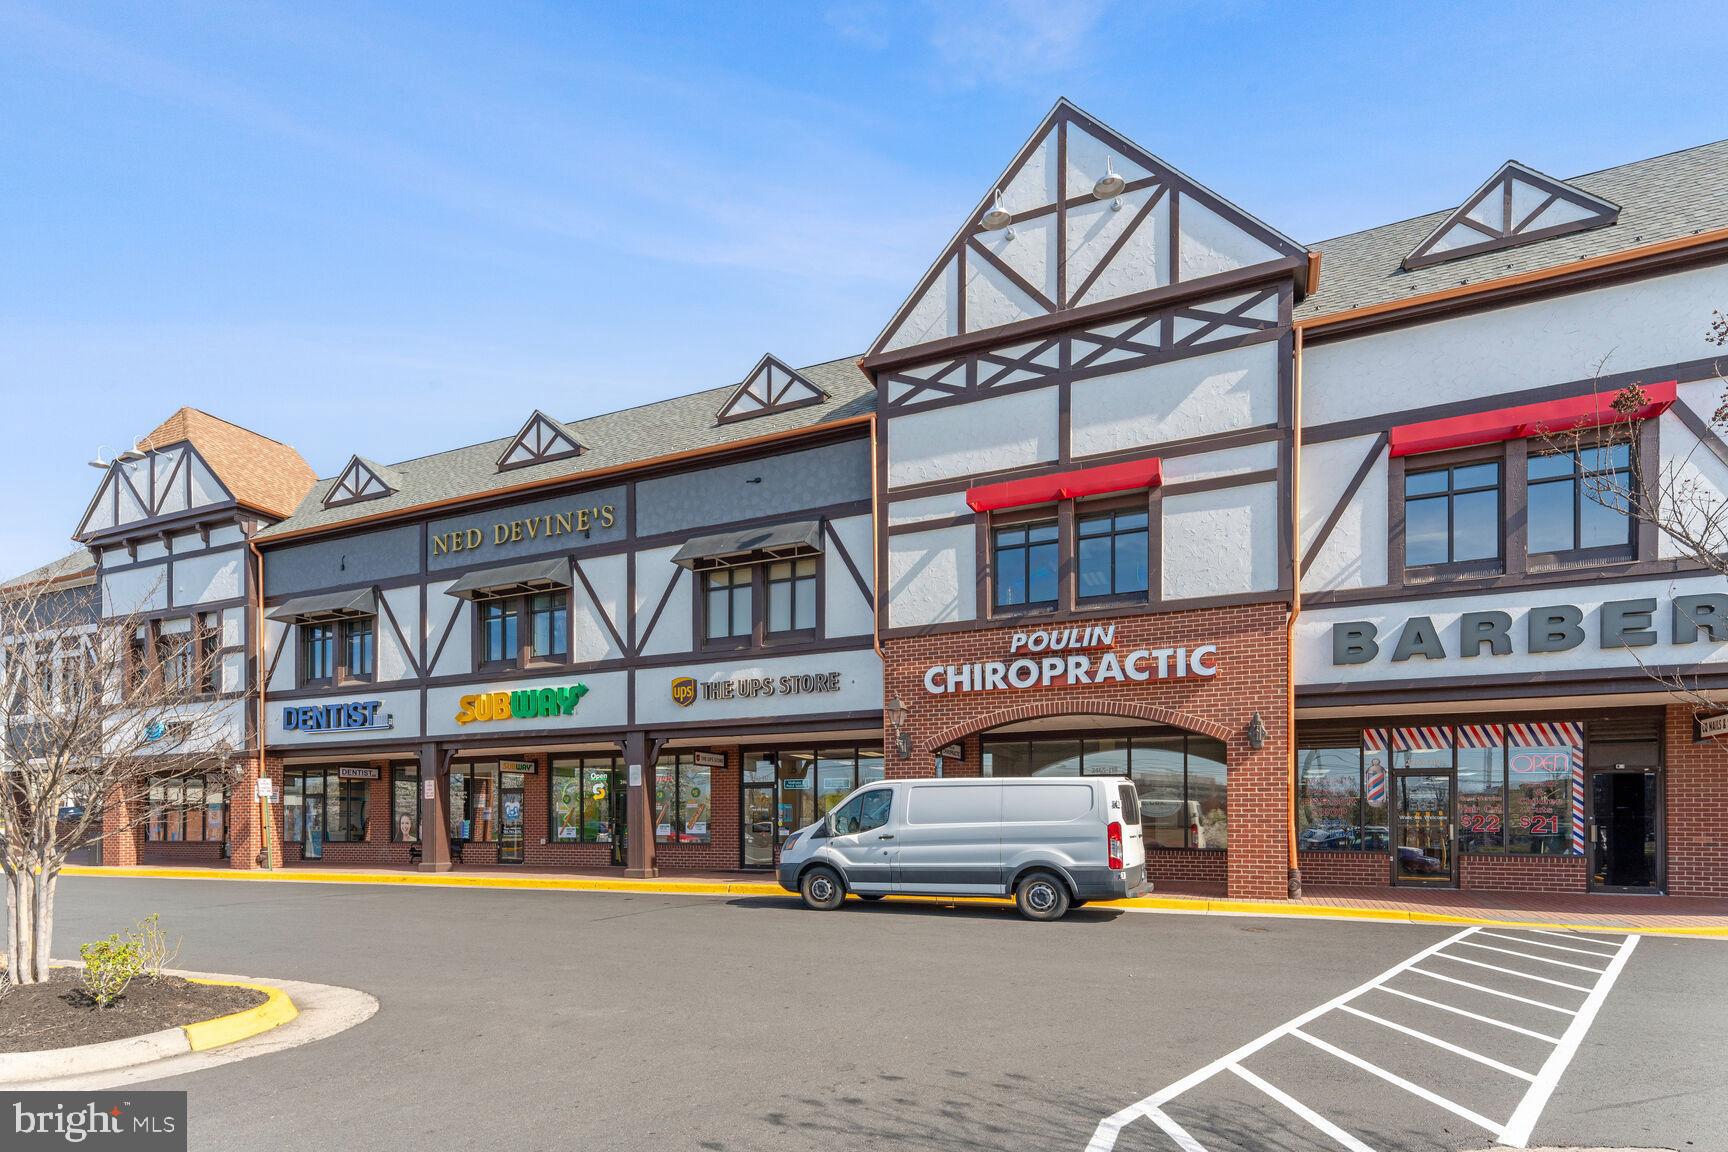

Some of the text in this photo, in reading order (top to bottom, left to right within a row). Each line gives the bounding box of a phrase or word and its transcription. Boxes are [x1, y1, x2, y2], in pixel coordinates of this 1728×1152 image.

[433, 505, 615, 555] NED DEVINE'S
[1010, 624, 1115, 652] POULIN
[1333, 592, 1728, 665] BARBER
[924, 645, 1216, 694] CHIROPRACTIC
[700, 672, 841, 700] THE UPS STORE
[283, 701, 381, 730] DENTIST
[455, 682, 589, 724] SUBWAY
[503, 763, 532, 771] SUBWAY
[1511, 753, 1569, 773] OPEN
[1460, 815, 1501, 833] $22
[1520, 815, 1558, 834] $21
